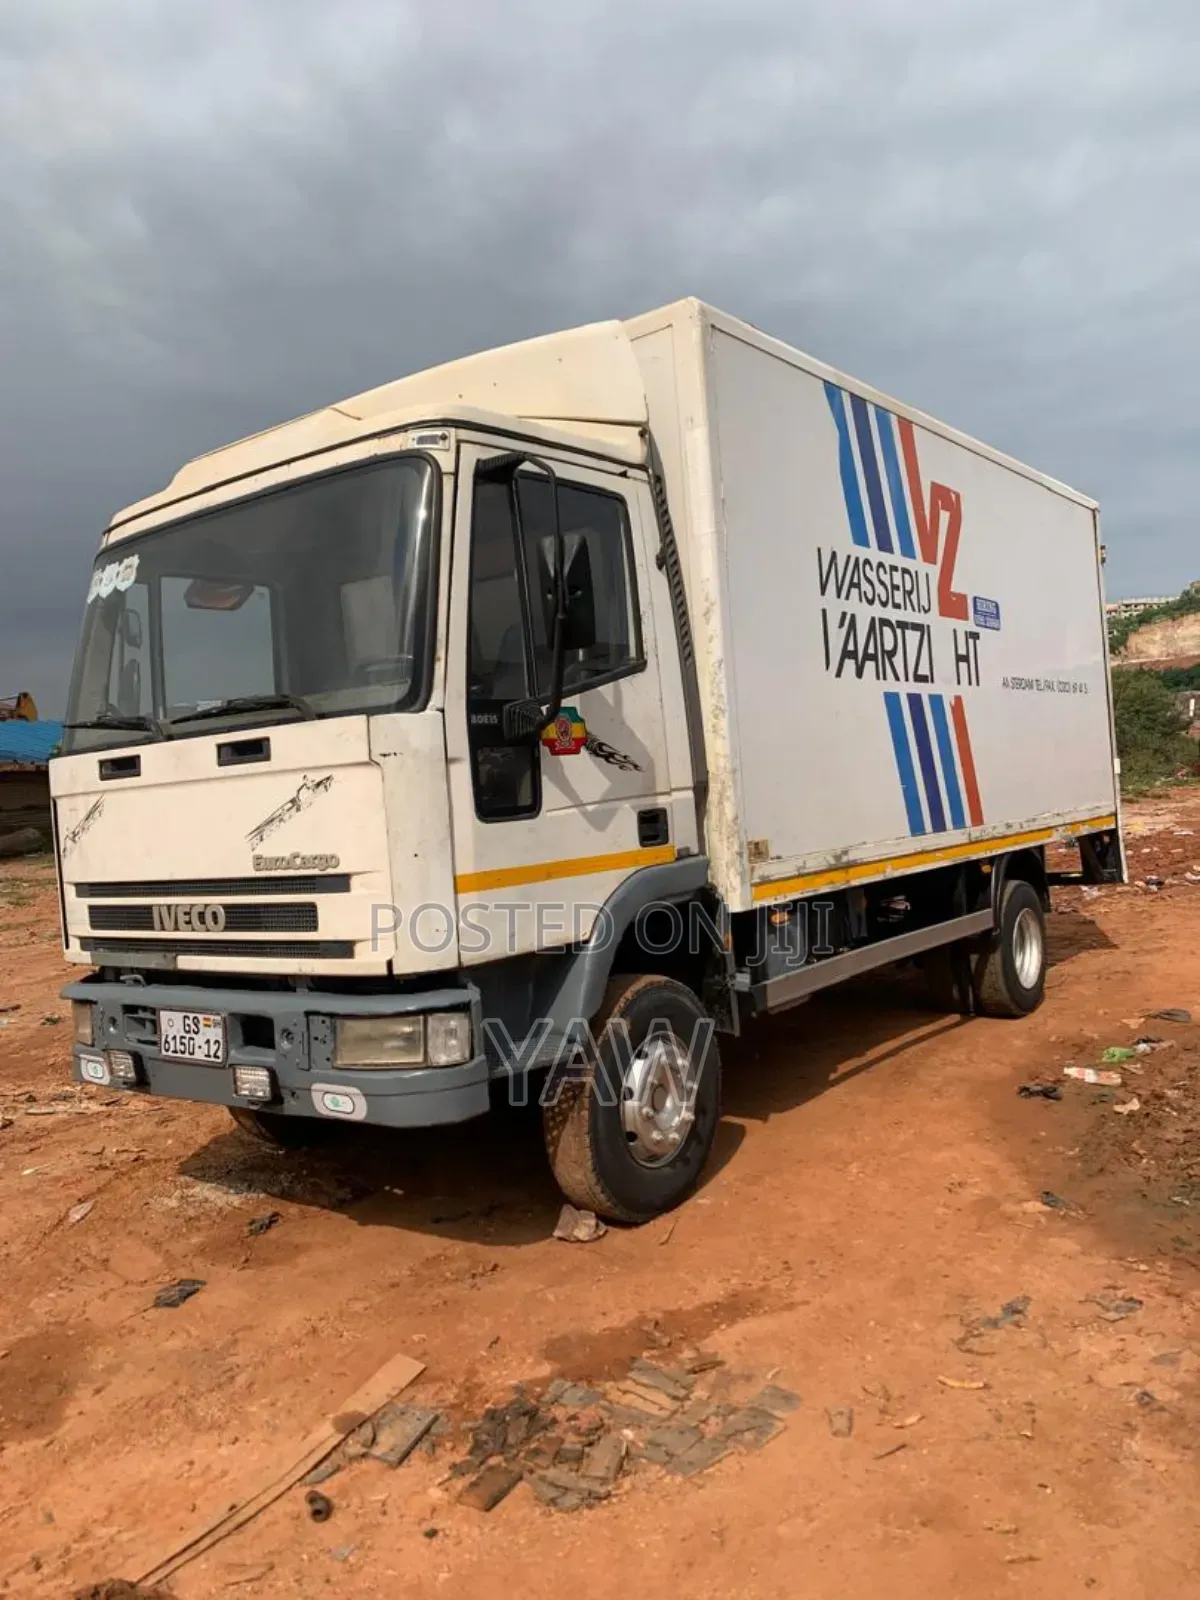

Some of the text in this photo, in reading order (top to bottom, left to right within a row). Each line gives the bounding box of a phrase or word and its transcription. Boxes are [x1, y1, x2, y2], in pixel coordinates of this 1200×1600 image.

[817, 547, 931, 614] WASSERIJ
[252, 852, 340, 871] EuroCargo
[152, 904, 226, 932] IVECO
[183, 1015, 200, 1035] GS
